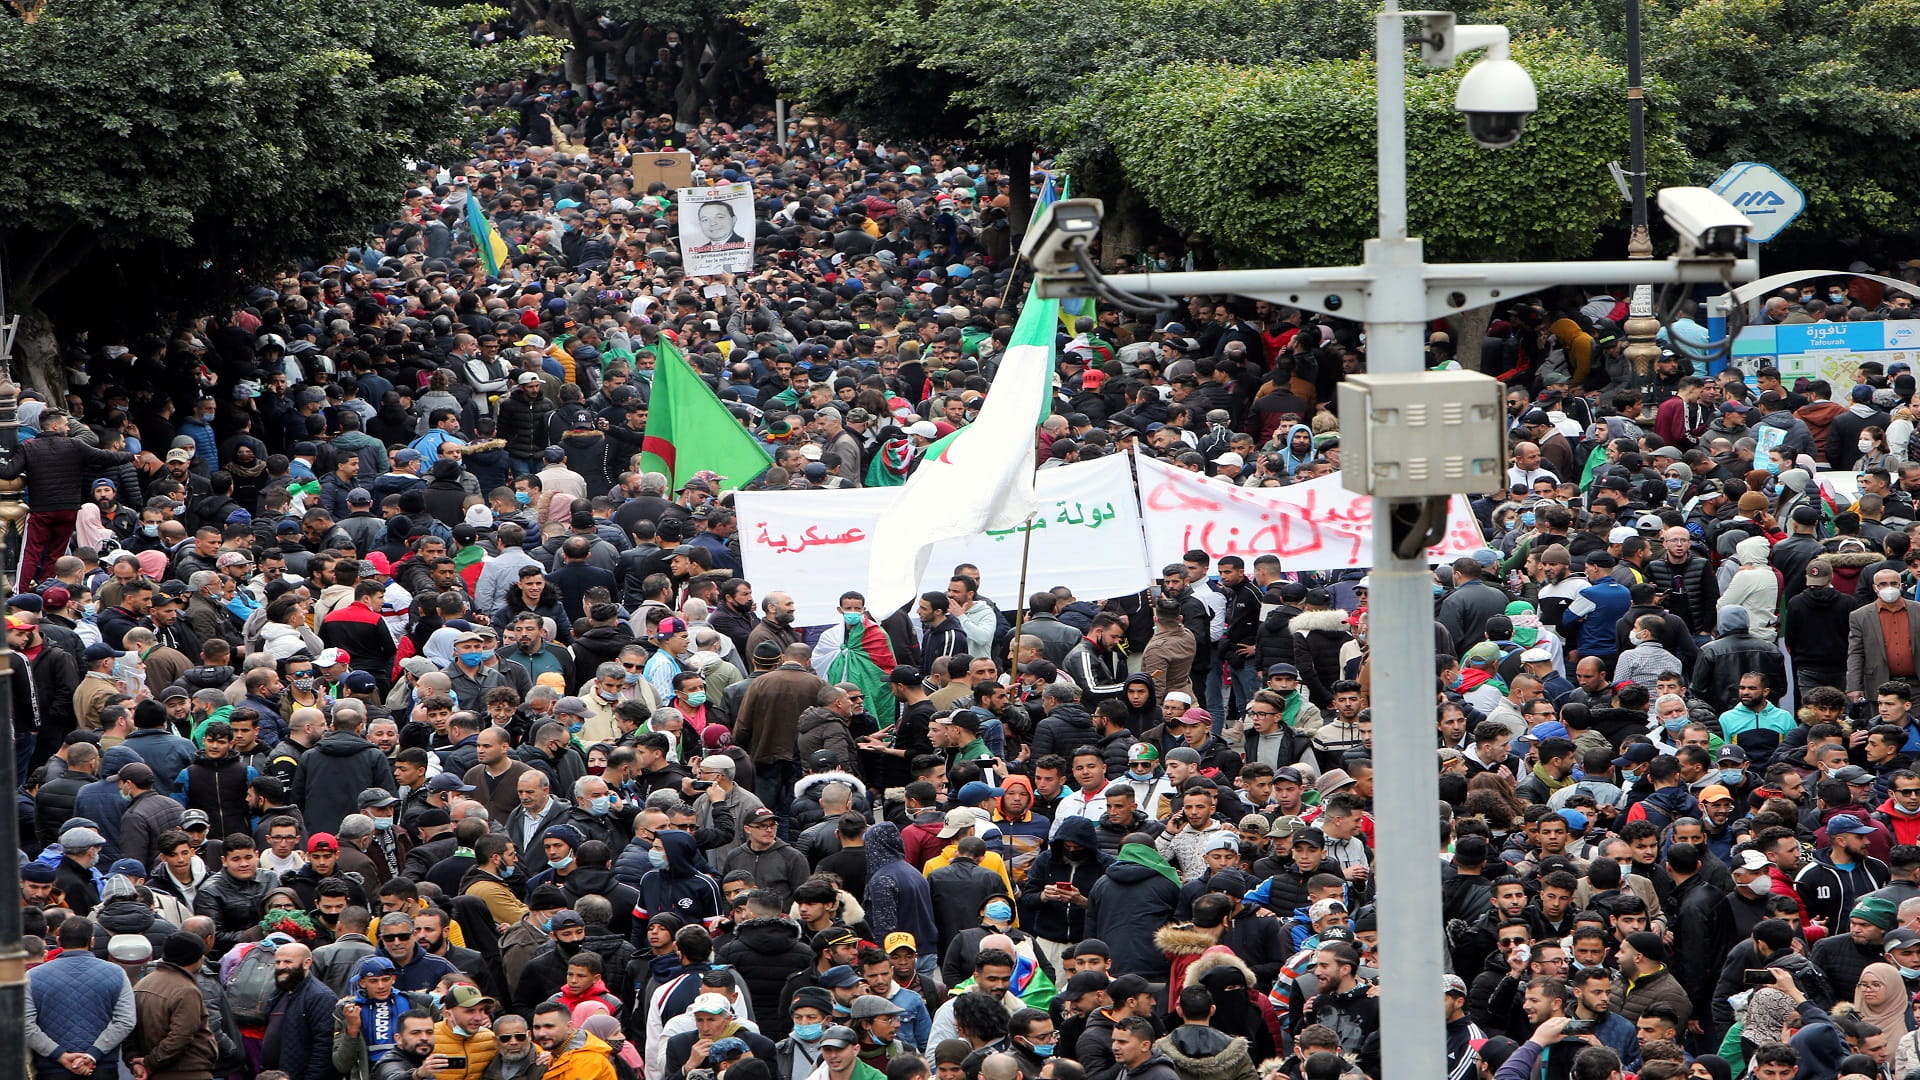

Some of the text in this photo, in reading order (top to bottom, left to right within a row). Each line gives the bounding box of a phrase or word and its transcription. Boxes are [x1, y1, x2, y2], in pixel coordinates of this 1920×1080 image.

[1806, 324, 1847, 339] تافورة
[1056, 501, 1116, 528] دولة
[756, 521, 866, 554] عسكرية
[1816, 885, 1831, 899] 10
[889, 934, 909, 945] EA7
